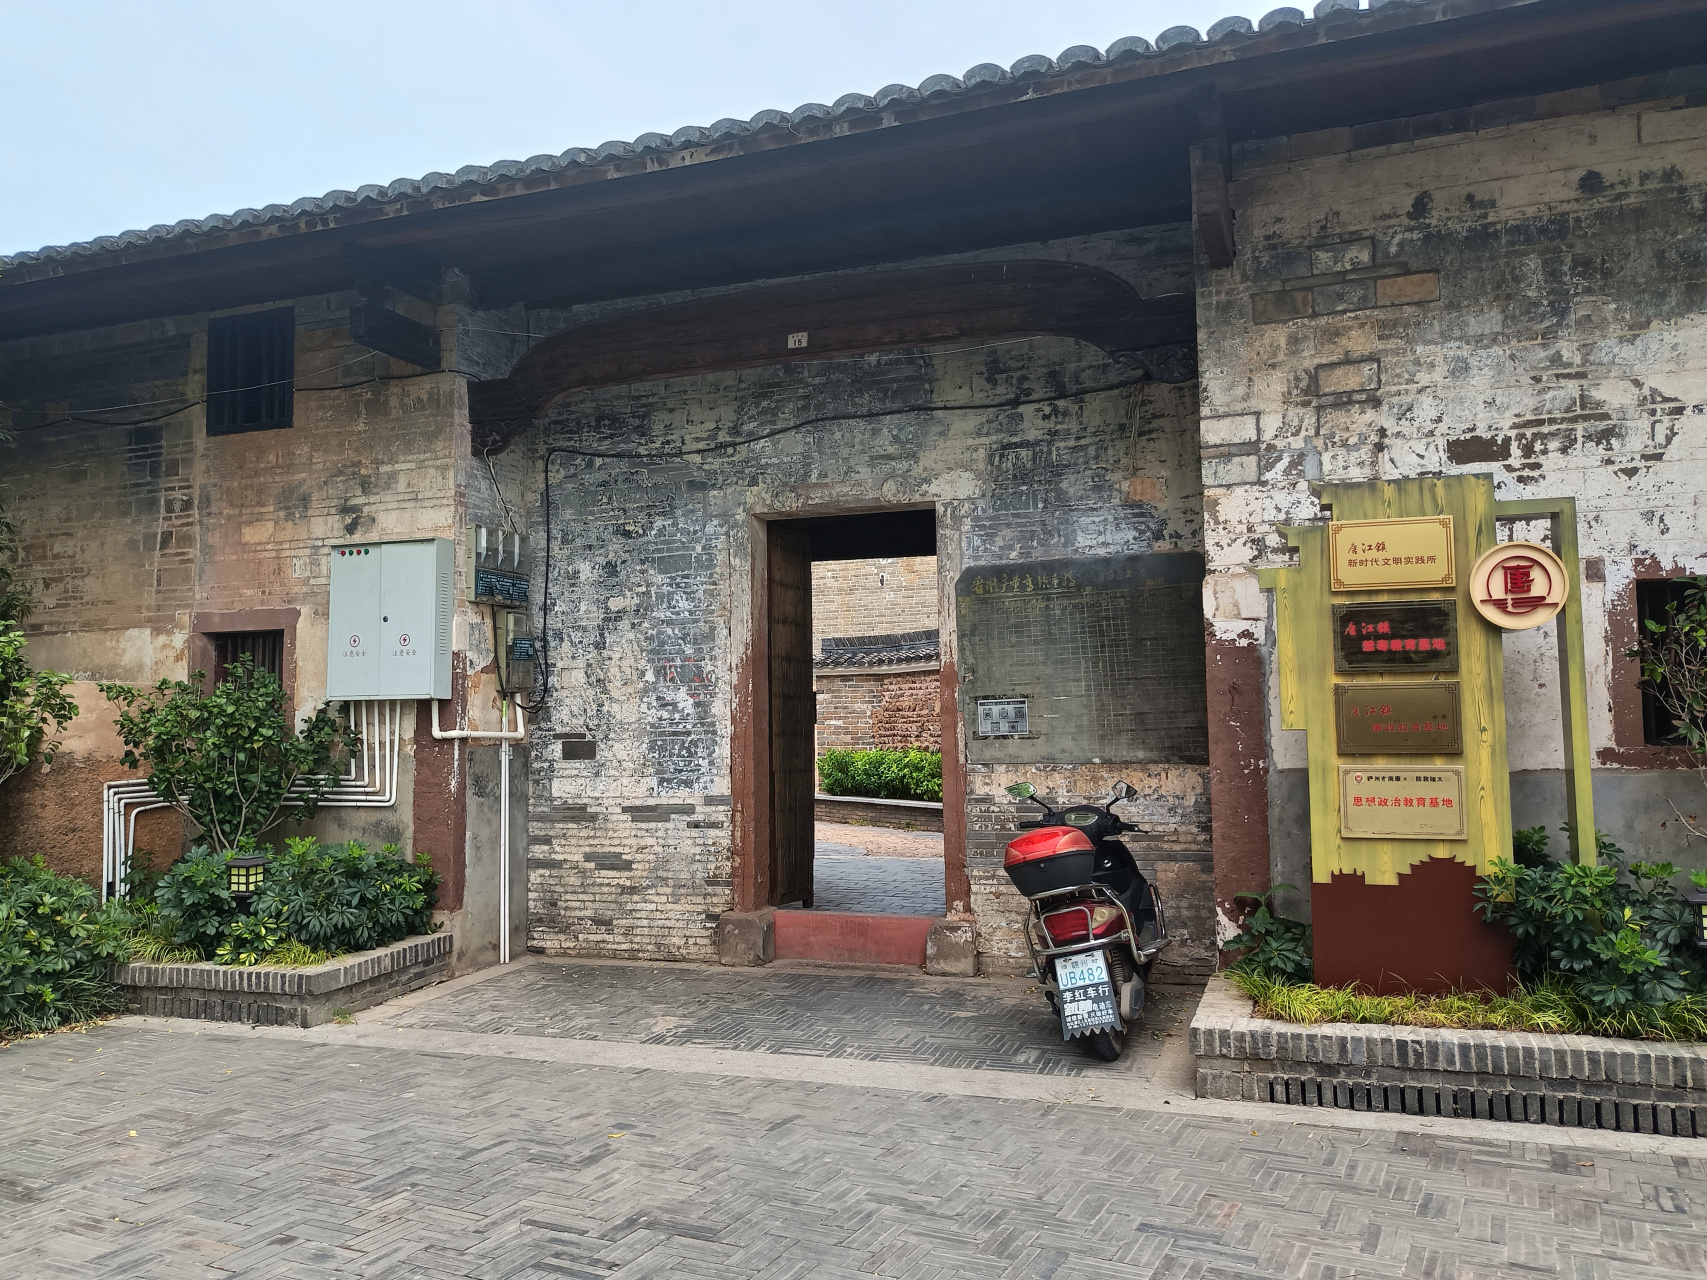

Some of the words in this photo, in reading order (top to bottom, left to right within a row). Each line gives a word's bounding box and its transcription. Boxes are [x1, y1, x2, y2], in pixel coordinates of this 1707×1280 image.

[1347, 555, 1437, 568] 新时代文明实践所
[1352, 796, 1454, 808] 思想政治教育基地
[1060, 966, 1104, 987] UB482
[1062, 984, 1109, 1002] 李红车行
